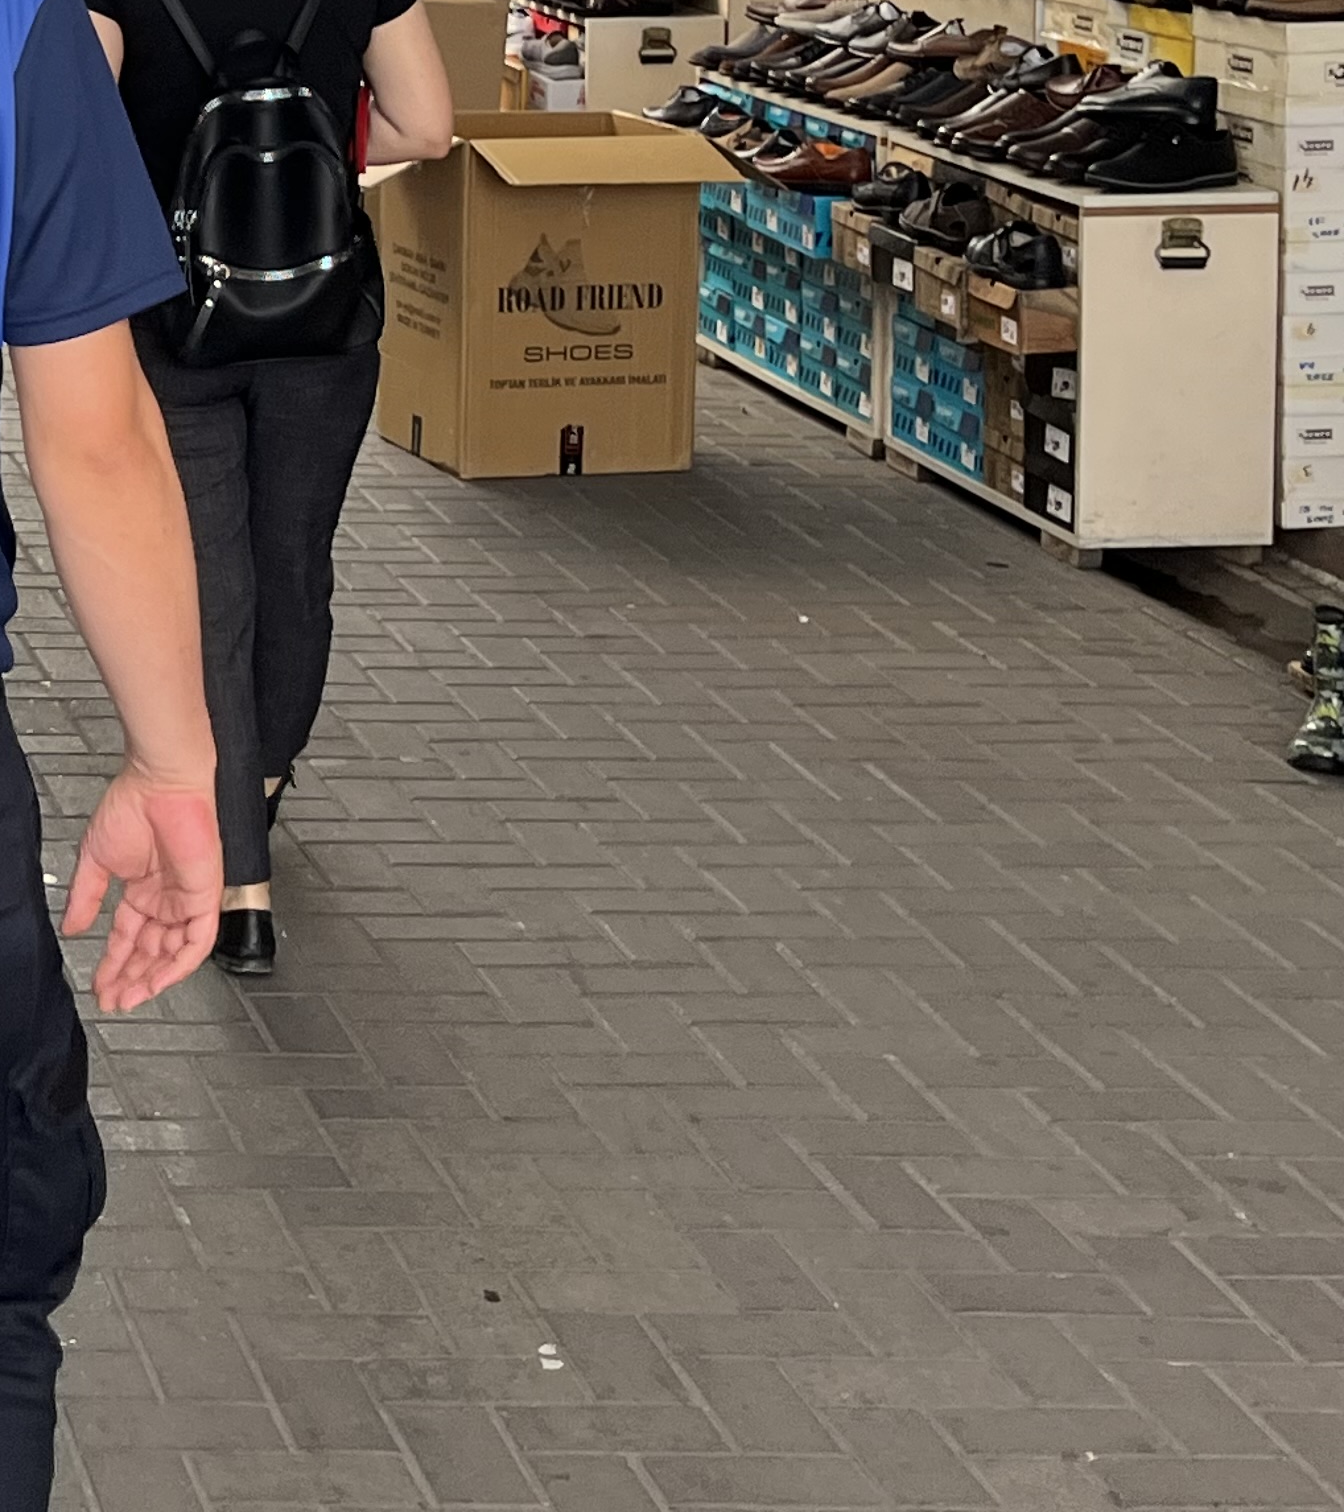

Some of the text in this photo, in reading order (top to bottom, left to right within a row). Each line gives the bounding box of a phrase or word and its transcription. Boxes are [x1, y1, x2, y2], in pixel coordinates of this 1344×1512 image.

[497, 282, 664, 314] ROAD FRIEND
[523, 343, 634, 363] SHOES
